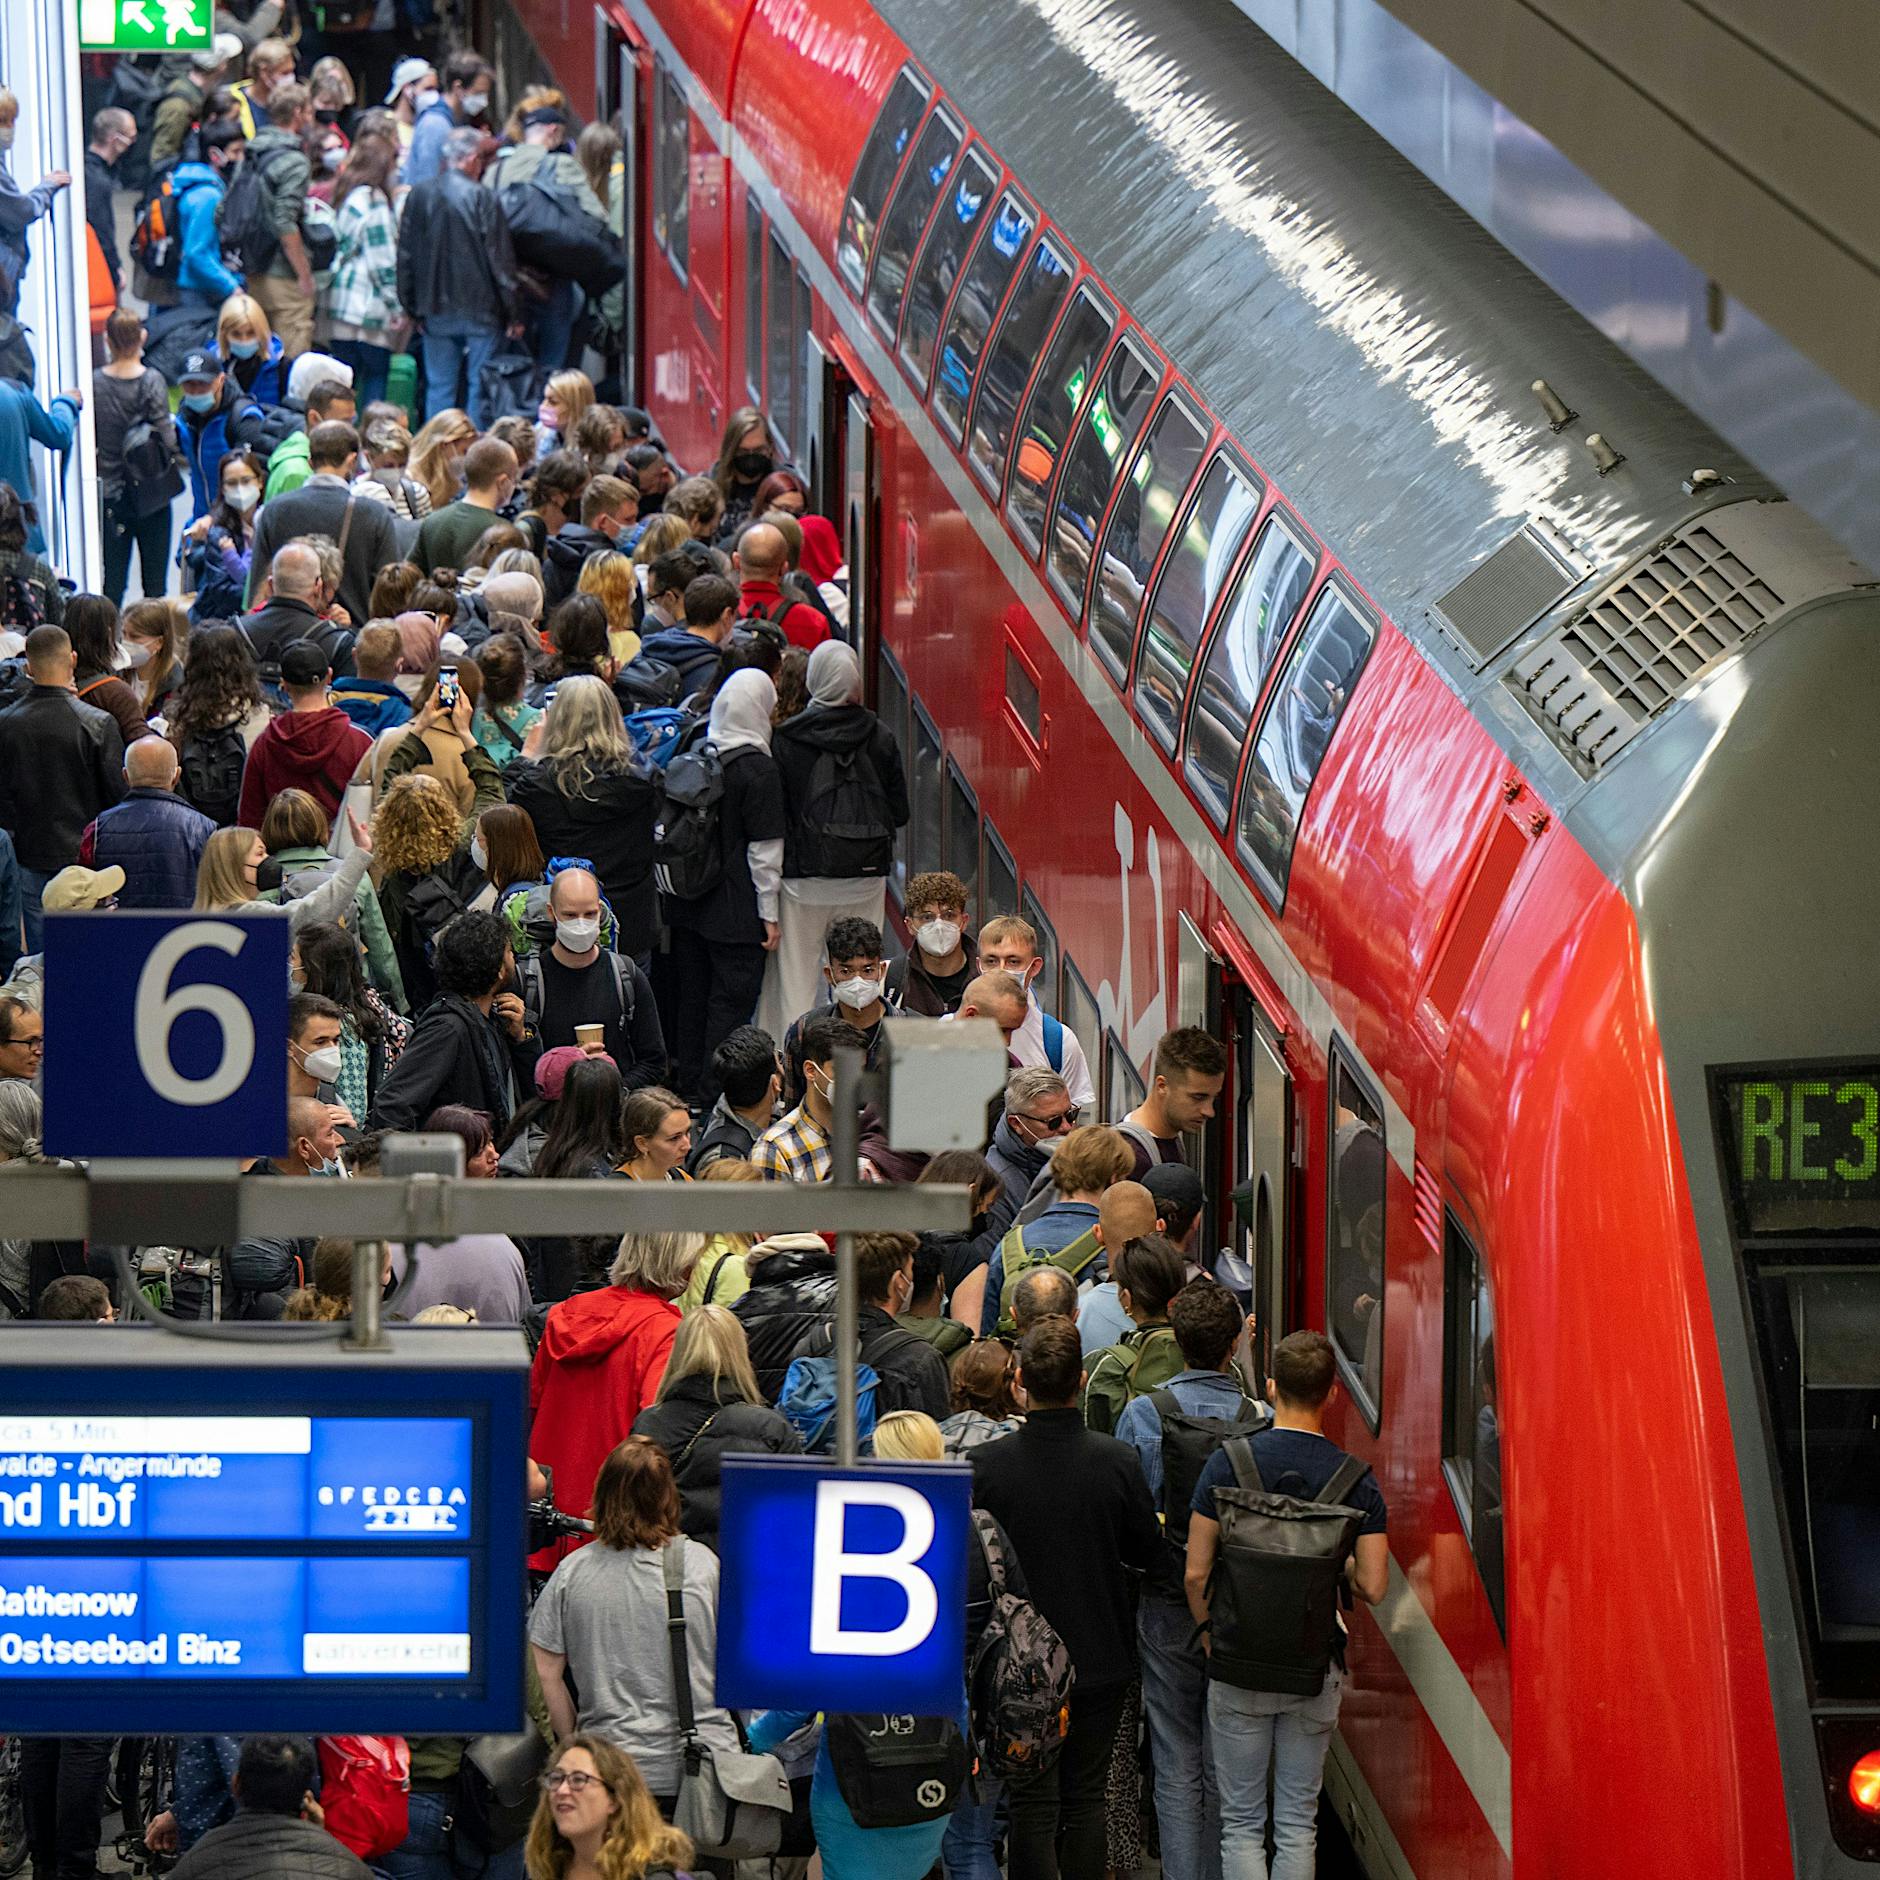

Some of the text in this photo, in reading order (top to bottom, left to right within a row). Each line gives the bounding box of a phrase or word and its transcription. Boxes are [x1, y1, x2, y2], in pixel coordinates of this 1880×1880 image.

[134, 919, 256, 1106] 6
[1742, 1082, 1878, 1180] RE3
[79, 1453, 222, 1483] Angermünde
[59, 1482, 136, 1527] Hbf
[810, 1480, 938, 1656] B
[0, 1632, 242, 1665] Ostseebad Binz
